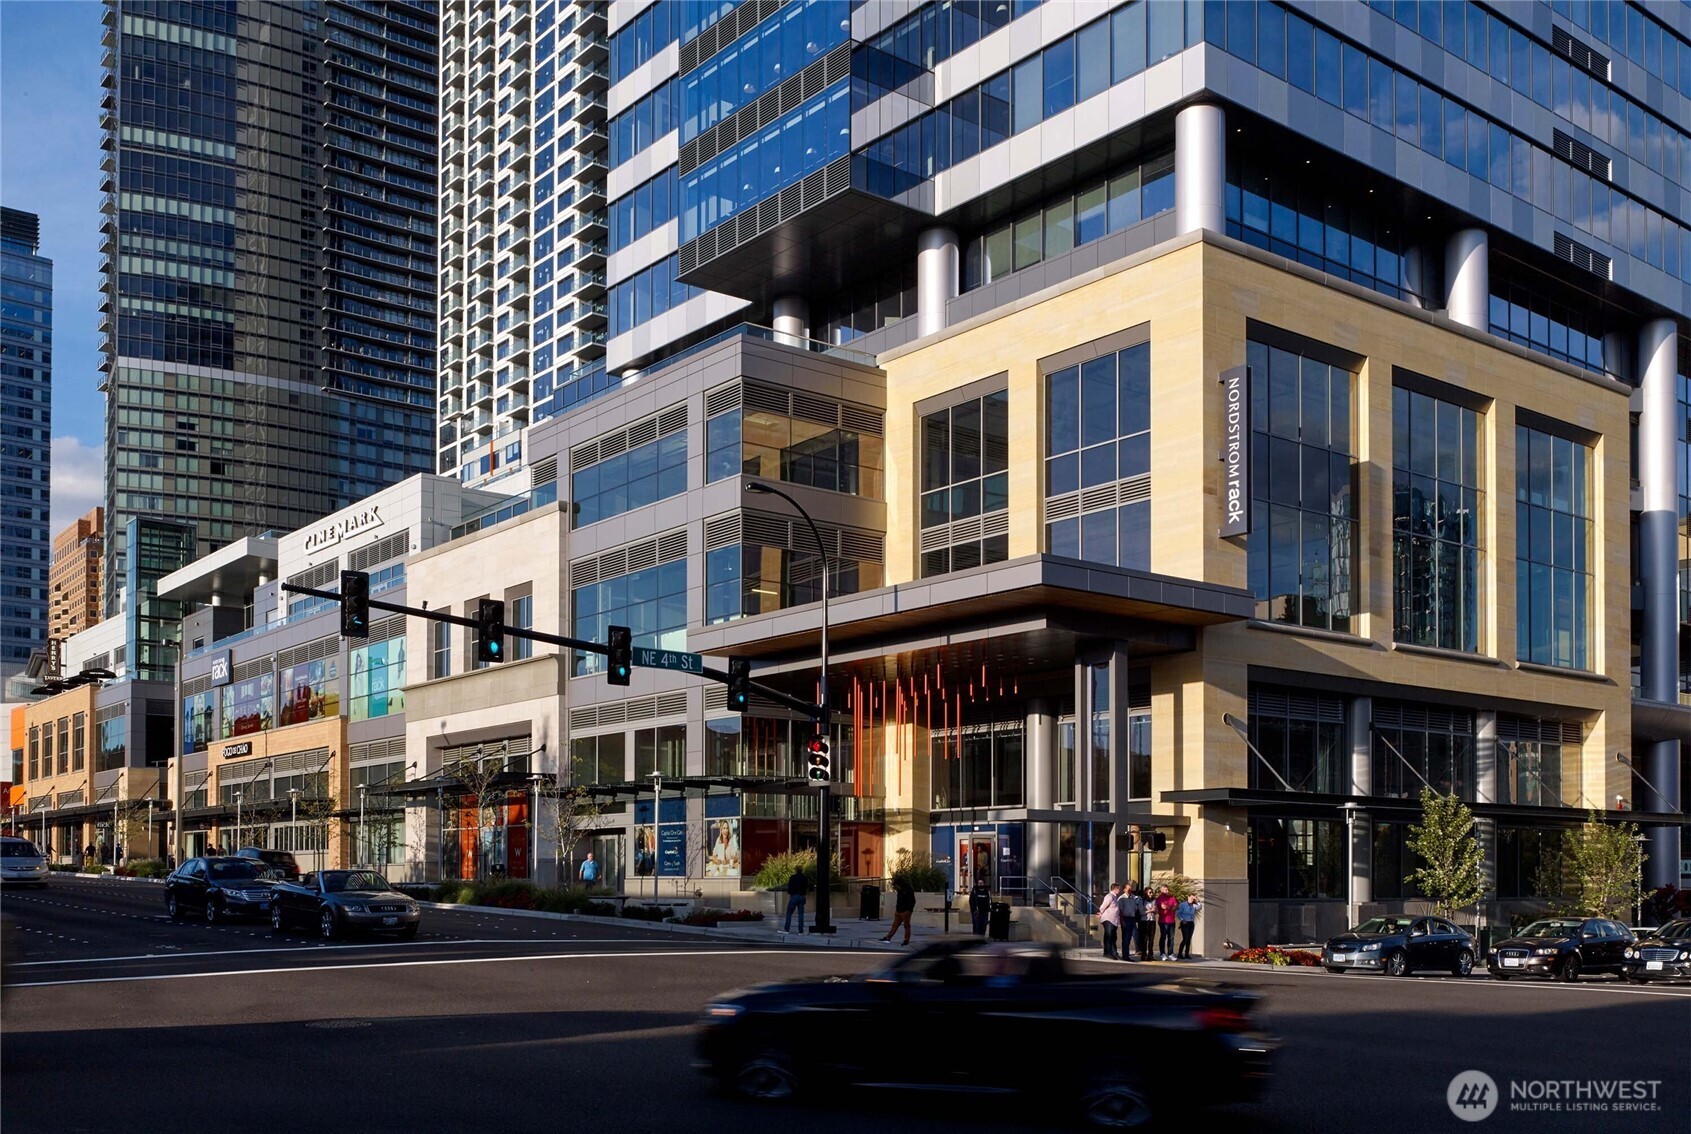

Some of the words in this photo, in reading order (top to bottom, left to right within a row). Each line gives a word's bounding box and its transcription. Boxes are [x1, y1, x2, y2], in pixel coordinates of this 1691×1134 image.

[1228, 377, 1240, 479] NORDSTROM
[1228, 480, 1244, 525] rack
[304, 505, 385, 556] CINEMARK
[212, 661, 228, 680] rack
[641, 650, 657, 666] NE
[661, 653, 677, 667] 4th
[681, 655, 693, 670] St
